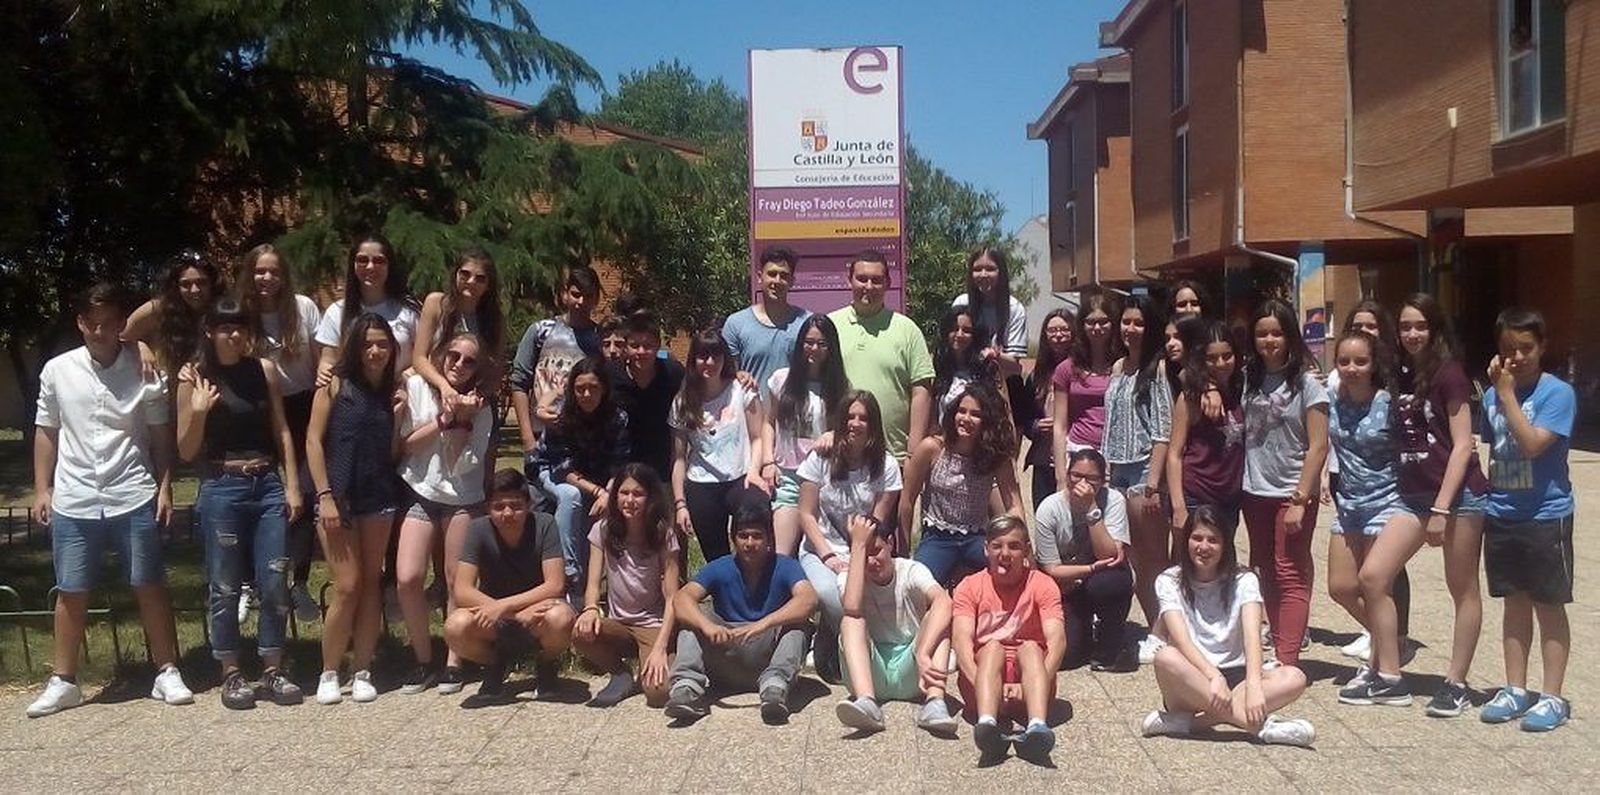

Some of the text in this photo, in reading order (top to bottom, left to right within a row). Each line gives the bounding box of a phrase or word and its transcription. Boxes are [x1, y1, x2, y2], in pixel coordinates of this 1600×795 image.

[843, 46, 888, 95] e
[834, 140, 894, 152] Junta de
[793, 152, 894, 167] Castilla y León
[840, 174, 850, 182] de
[853, 173, 895, 182] Educación
[758, 195, 894, 213] Fray Diego Tadeo González
